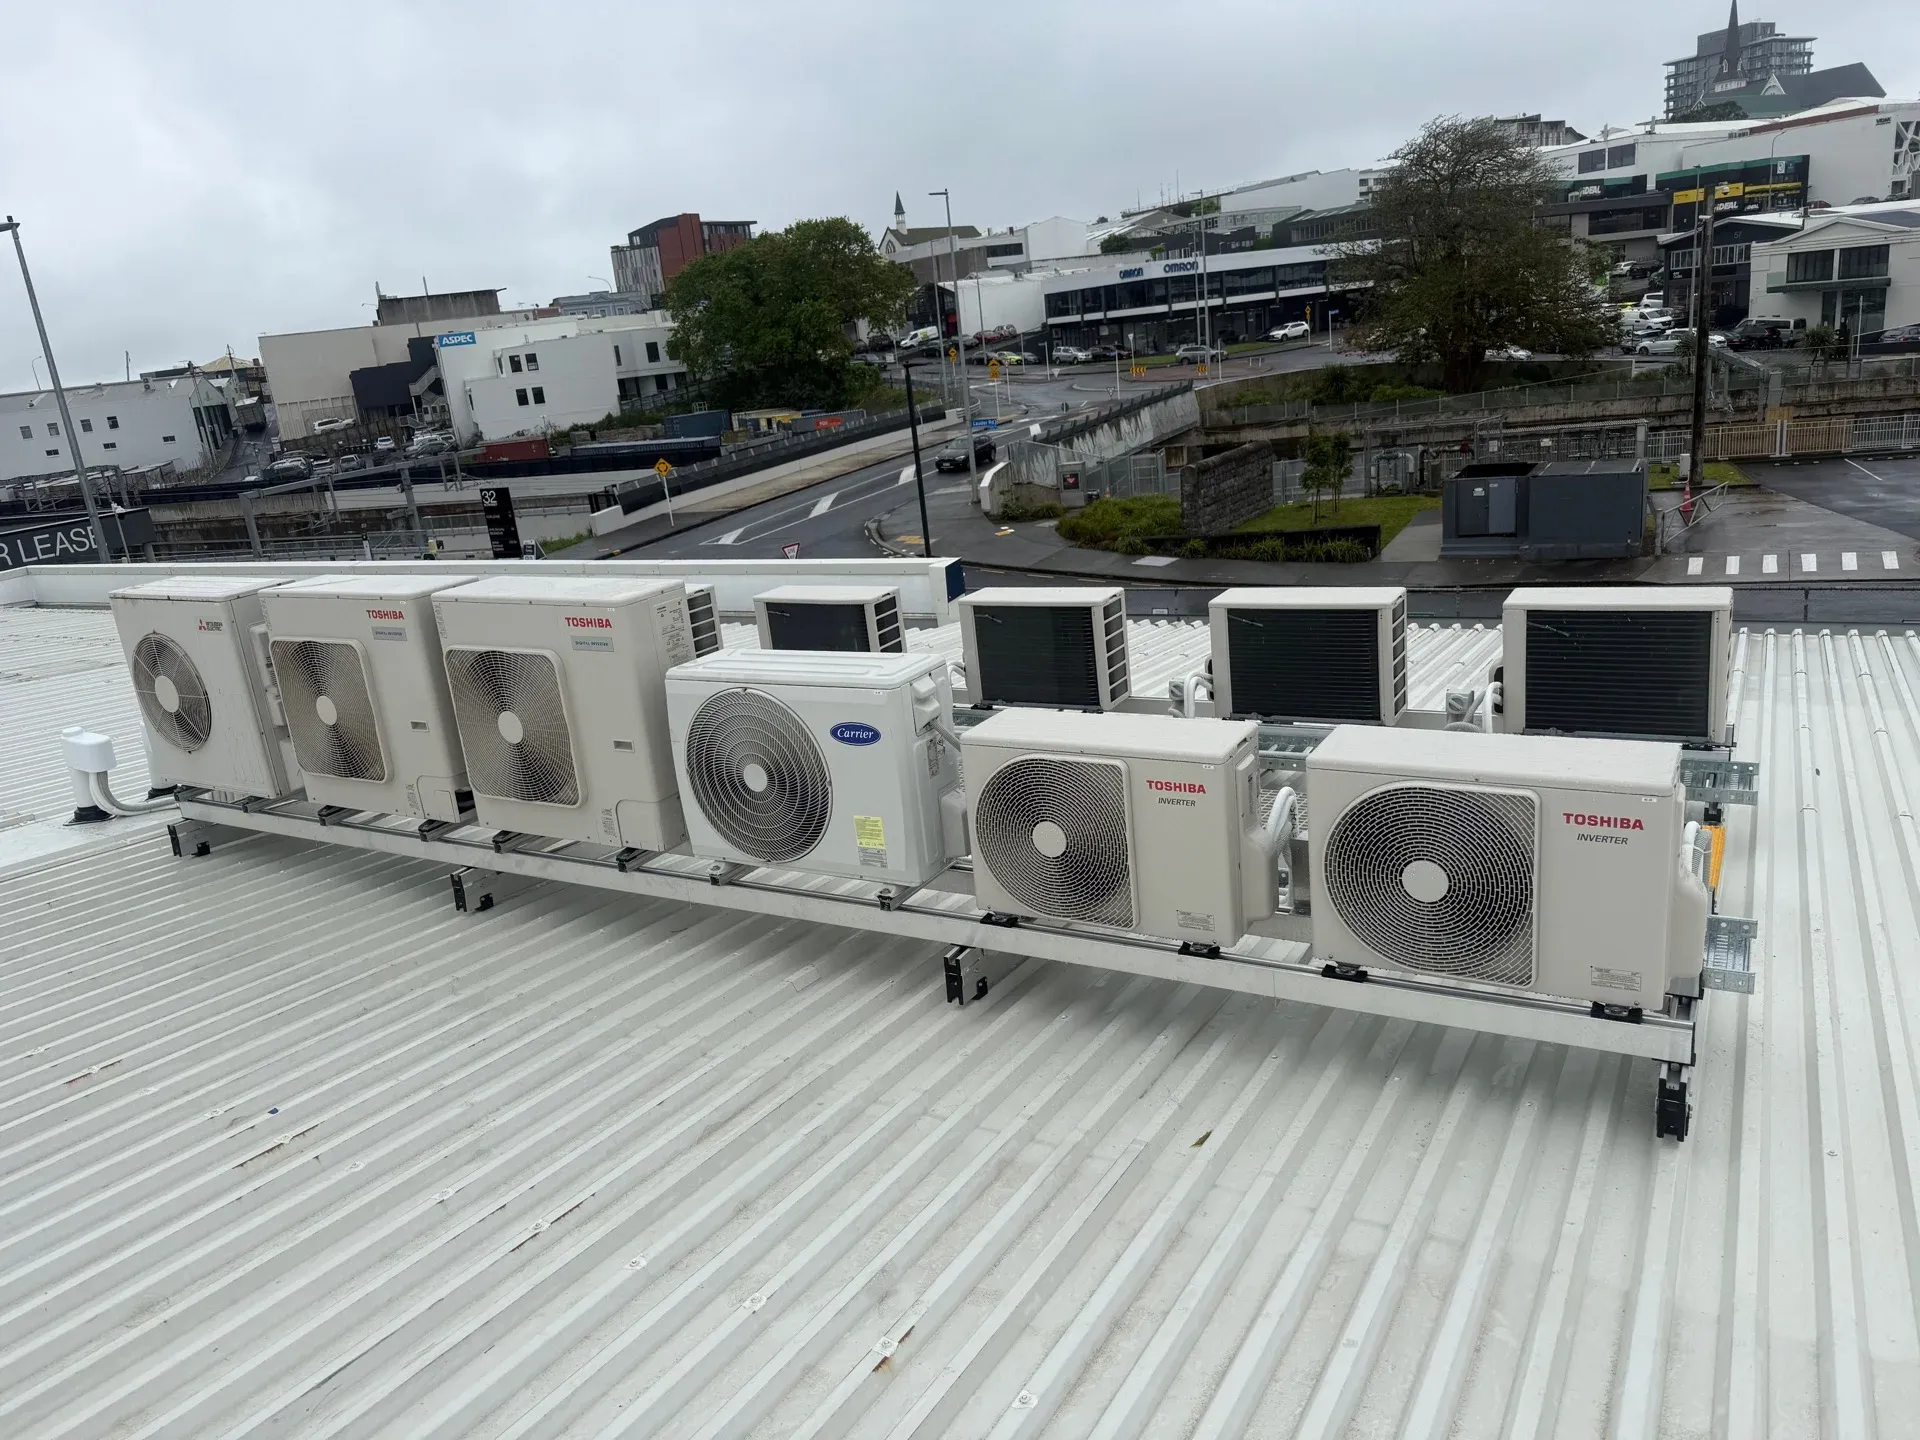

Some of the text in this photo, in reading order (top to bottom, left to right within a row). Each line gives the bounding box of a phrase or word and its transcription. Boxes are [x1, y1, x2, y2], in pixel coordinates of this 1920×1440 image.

[442, 335, 473, 345] ASPEC
[481, 490, 498, 504] 32
[366, 609, 405, 620] TOSHIBA
[565, 617, 613, 629] TOSHIBA
[837, 727, 874, 739] Carrier
[1146, 780, 1207, 794] TOSHIBA
[1158, 797, 1196, 807] INVERTER
[1563, 812, 1645, 831] TOSHIBA
[1576, 833, 1629, 845] INVERTER
